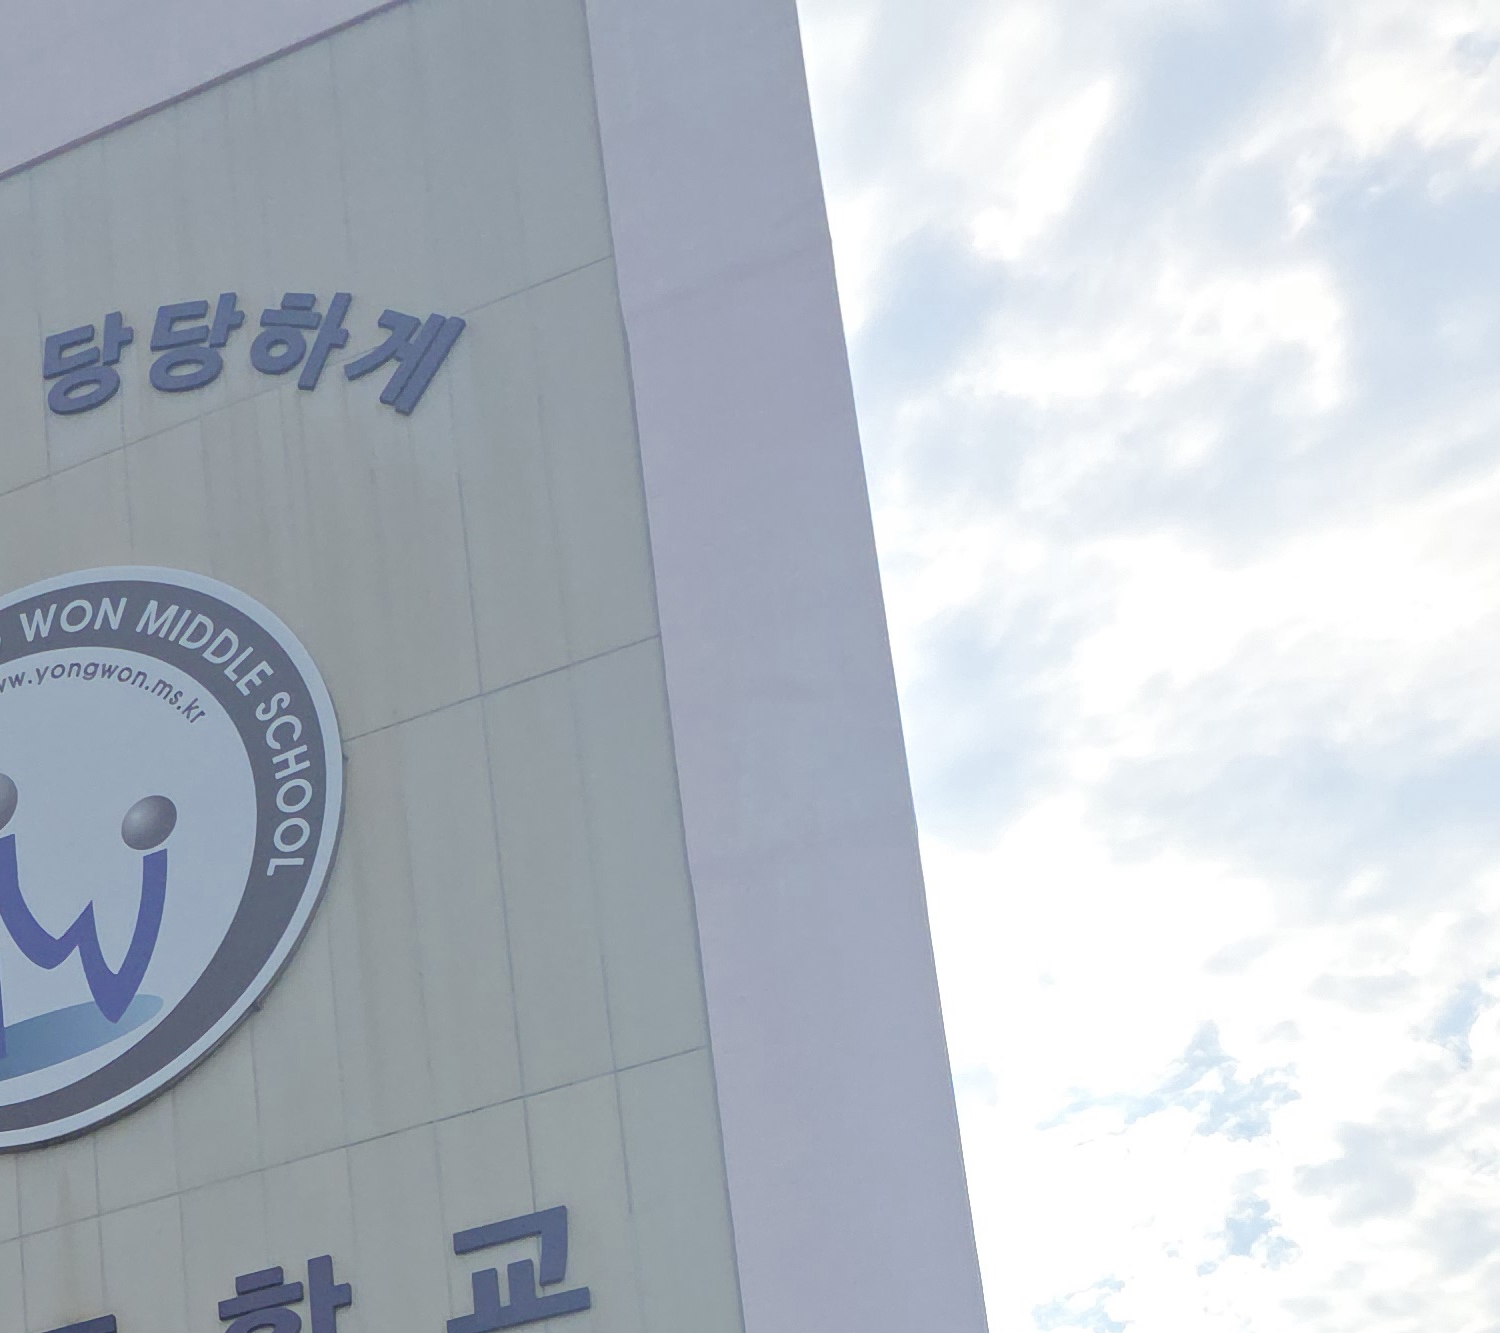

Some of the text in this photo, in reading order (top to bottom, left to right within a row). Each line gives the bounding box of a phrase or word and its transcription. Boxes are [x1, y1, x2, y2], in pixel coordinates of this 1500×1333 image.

[44, 292, 466, 416] 당당하게
[19, 598, 127, 642] WON
[136, 600, 274, 696] MIDDLE
[255, 692, 313, 876] SCHOOL
